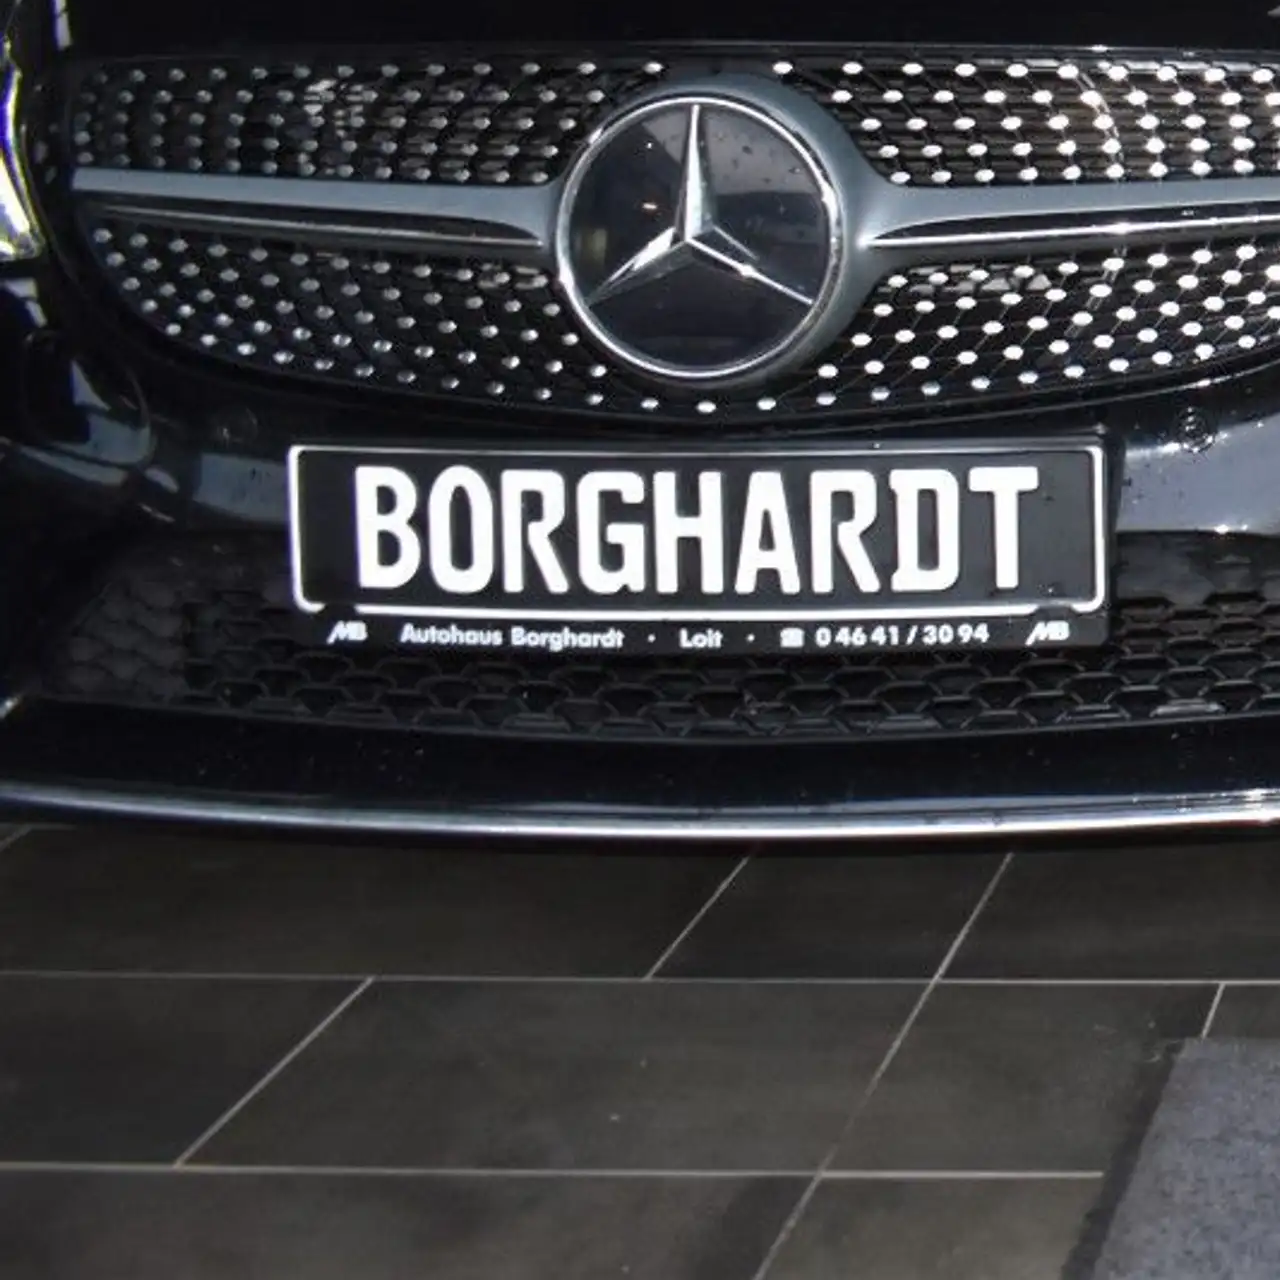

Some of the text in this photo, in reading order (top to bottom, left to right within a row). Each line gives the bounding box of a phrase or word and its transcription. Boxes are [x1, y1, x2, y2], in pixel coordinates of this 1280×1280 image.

[354, 464, 1040, 595] BORGHARDT
[400, 623, 504, 646] Autohaus
[510, 625, 625, 652] Borghardt
[679, 627, 724, 649] Loit
